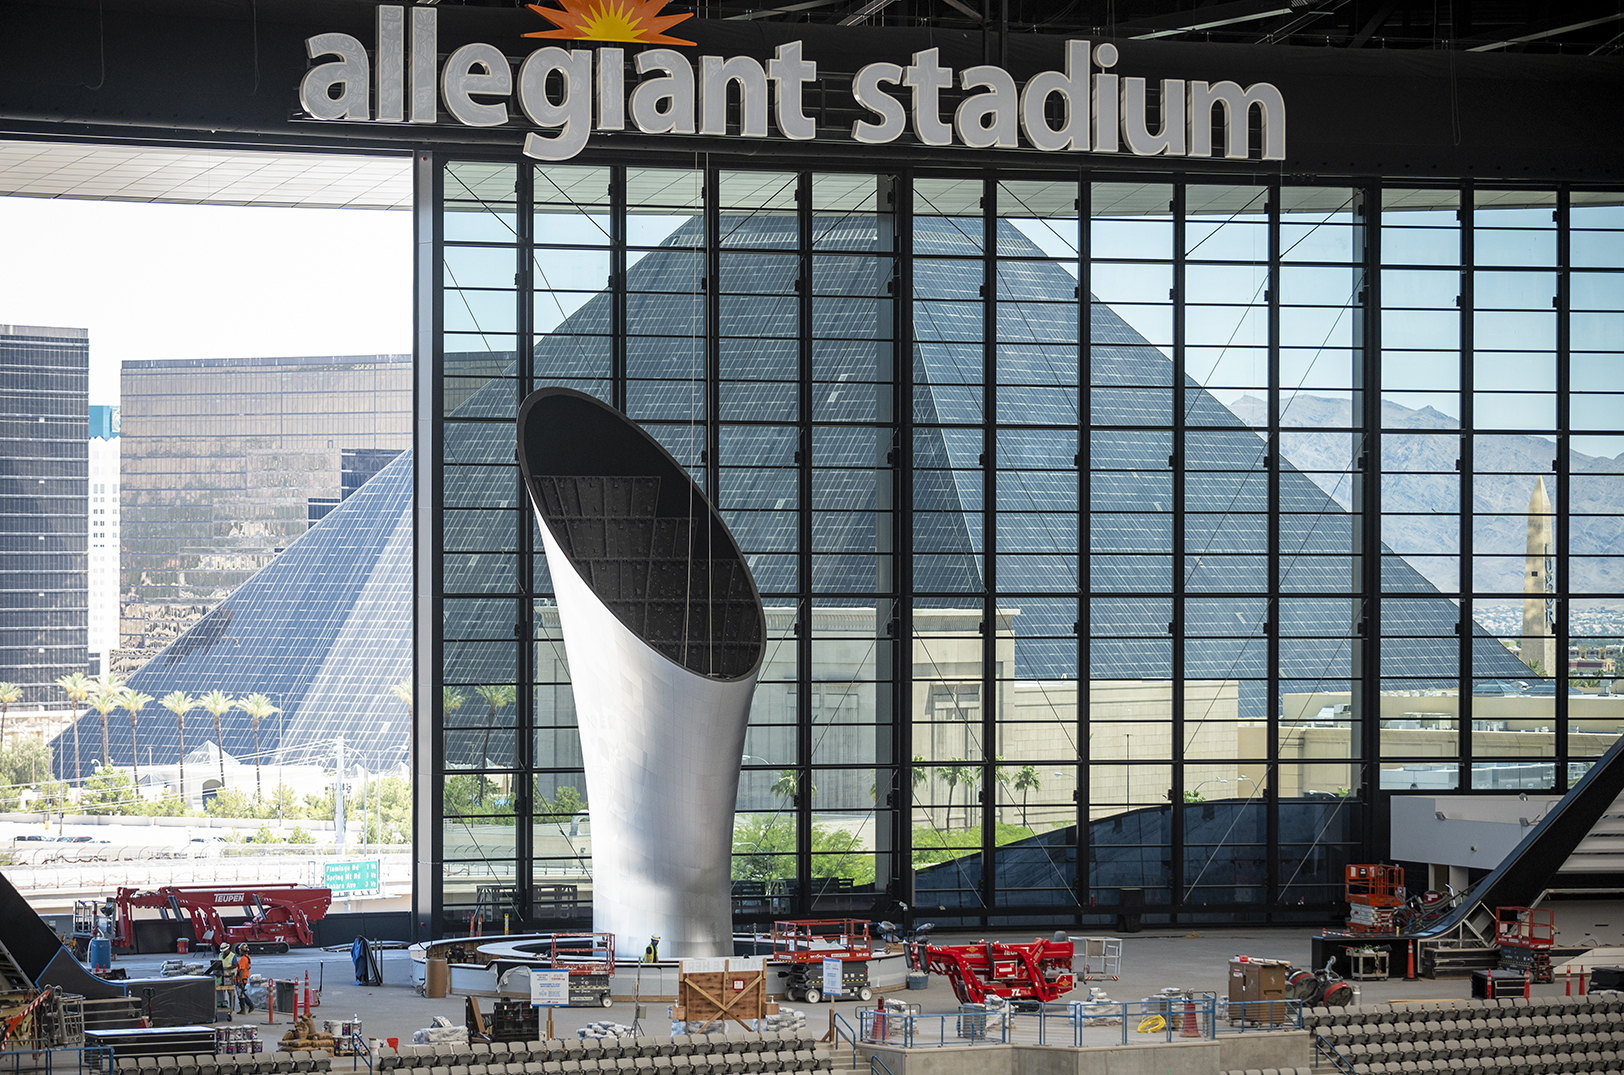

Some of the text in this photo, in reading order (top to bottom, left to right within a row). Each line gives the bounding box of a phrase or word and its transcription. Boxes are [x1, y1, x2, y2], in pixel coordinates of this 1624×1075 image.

[300, 4, 1286, 161] allegiant stadium
[326, 865, 350, 873] Flamingo
[326, 874, 344, 882] Spring
[214, 893, 245, 902] TEUPEN
